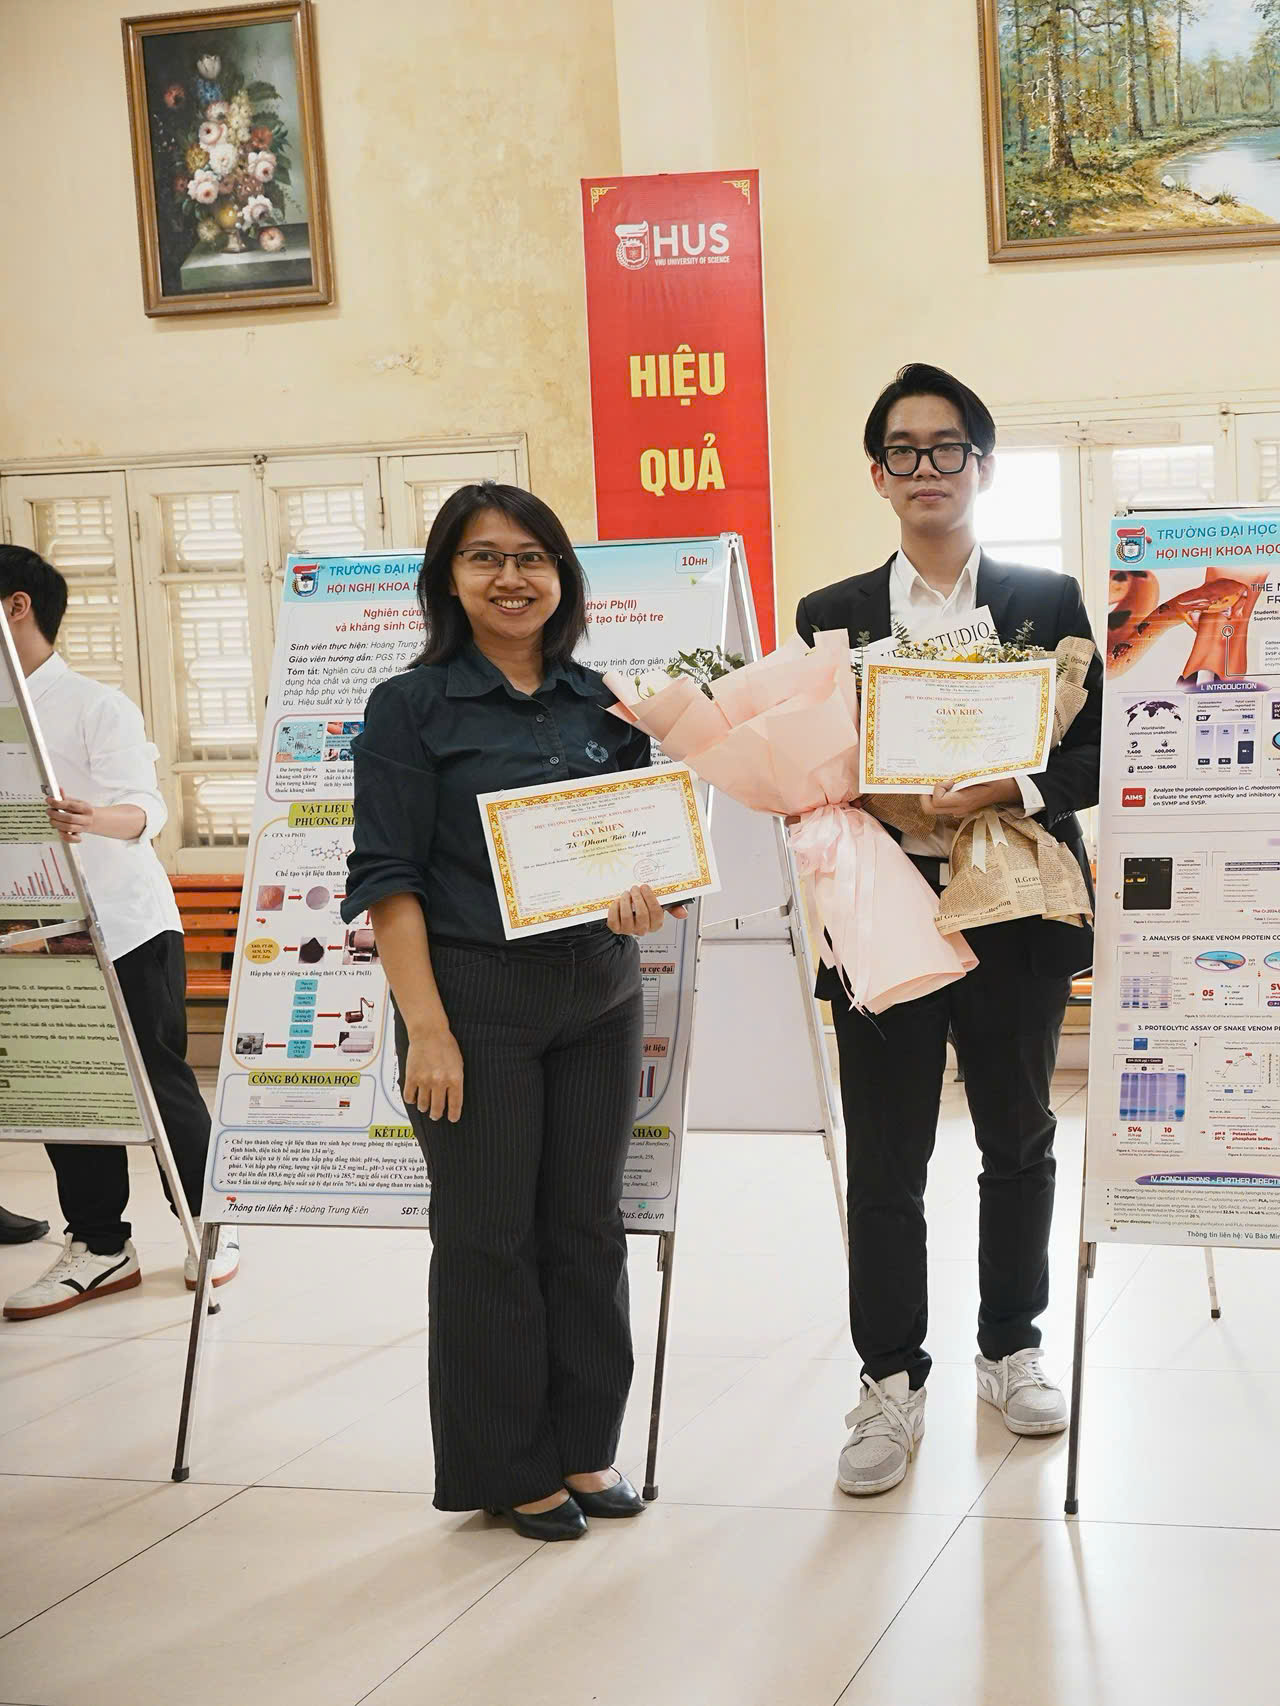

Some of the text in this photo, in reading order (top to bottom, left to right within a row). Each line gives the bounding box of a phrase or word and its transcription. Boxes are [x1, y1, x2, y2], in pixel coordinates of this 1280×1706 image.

[653, 223, 730, 256] HUS
[655, 256, 730, 266] VNU UNIVERSITY OF SCIENCE
[629, 344, 726, 406] HIỆU
[640, 432, 726, 496] QUẢ
[1158, 526, 1216, 540] TRƯỜNG
[1220, 525, 1244, 538] ĐẠI
[1248, 524, 1278, 538] HỌC
[682, 556, 708, 566] 10HH
[330, 563, 404, 576] TRƯỜNG ĐẠI
[1250, 583, 1273, 592] THE
[586, 600, 607, 610] thời
[364, 608, 398, 619] Nghiên
[596, 613, 664, 625] tạo từ bột tre
[350, 621, 405, 633] kháng sinh
[1206, 683, 1257, 691] INTRODUCTION
[598, 823, 624, 833] KHEN
[252, 1073, 282, 1084] CÔNG
[301, 1075, 334, 1084] KHOA
[335, 1075, 357, 1086] HỌC
[1187, 1231, 1207, 1239] Thông
